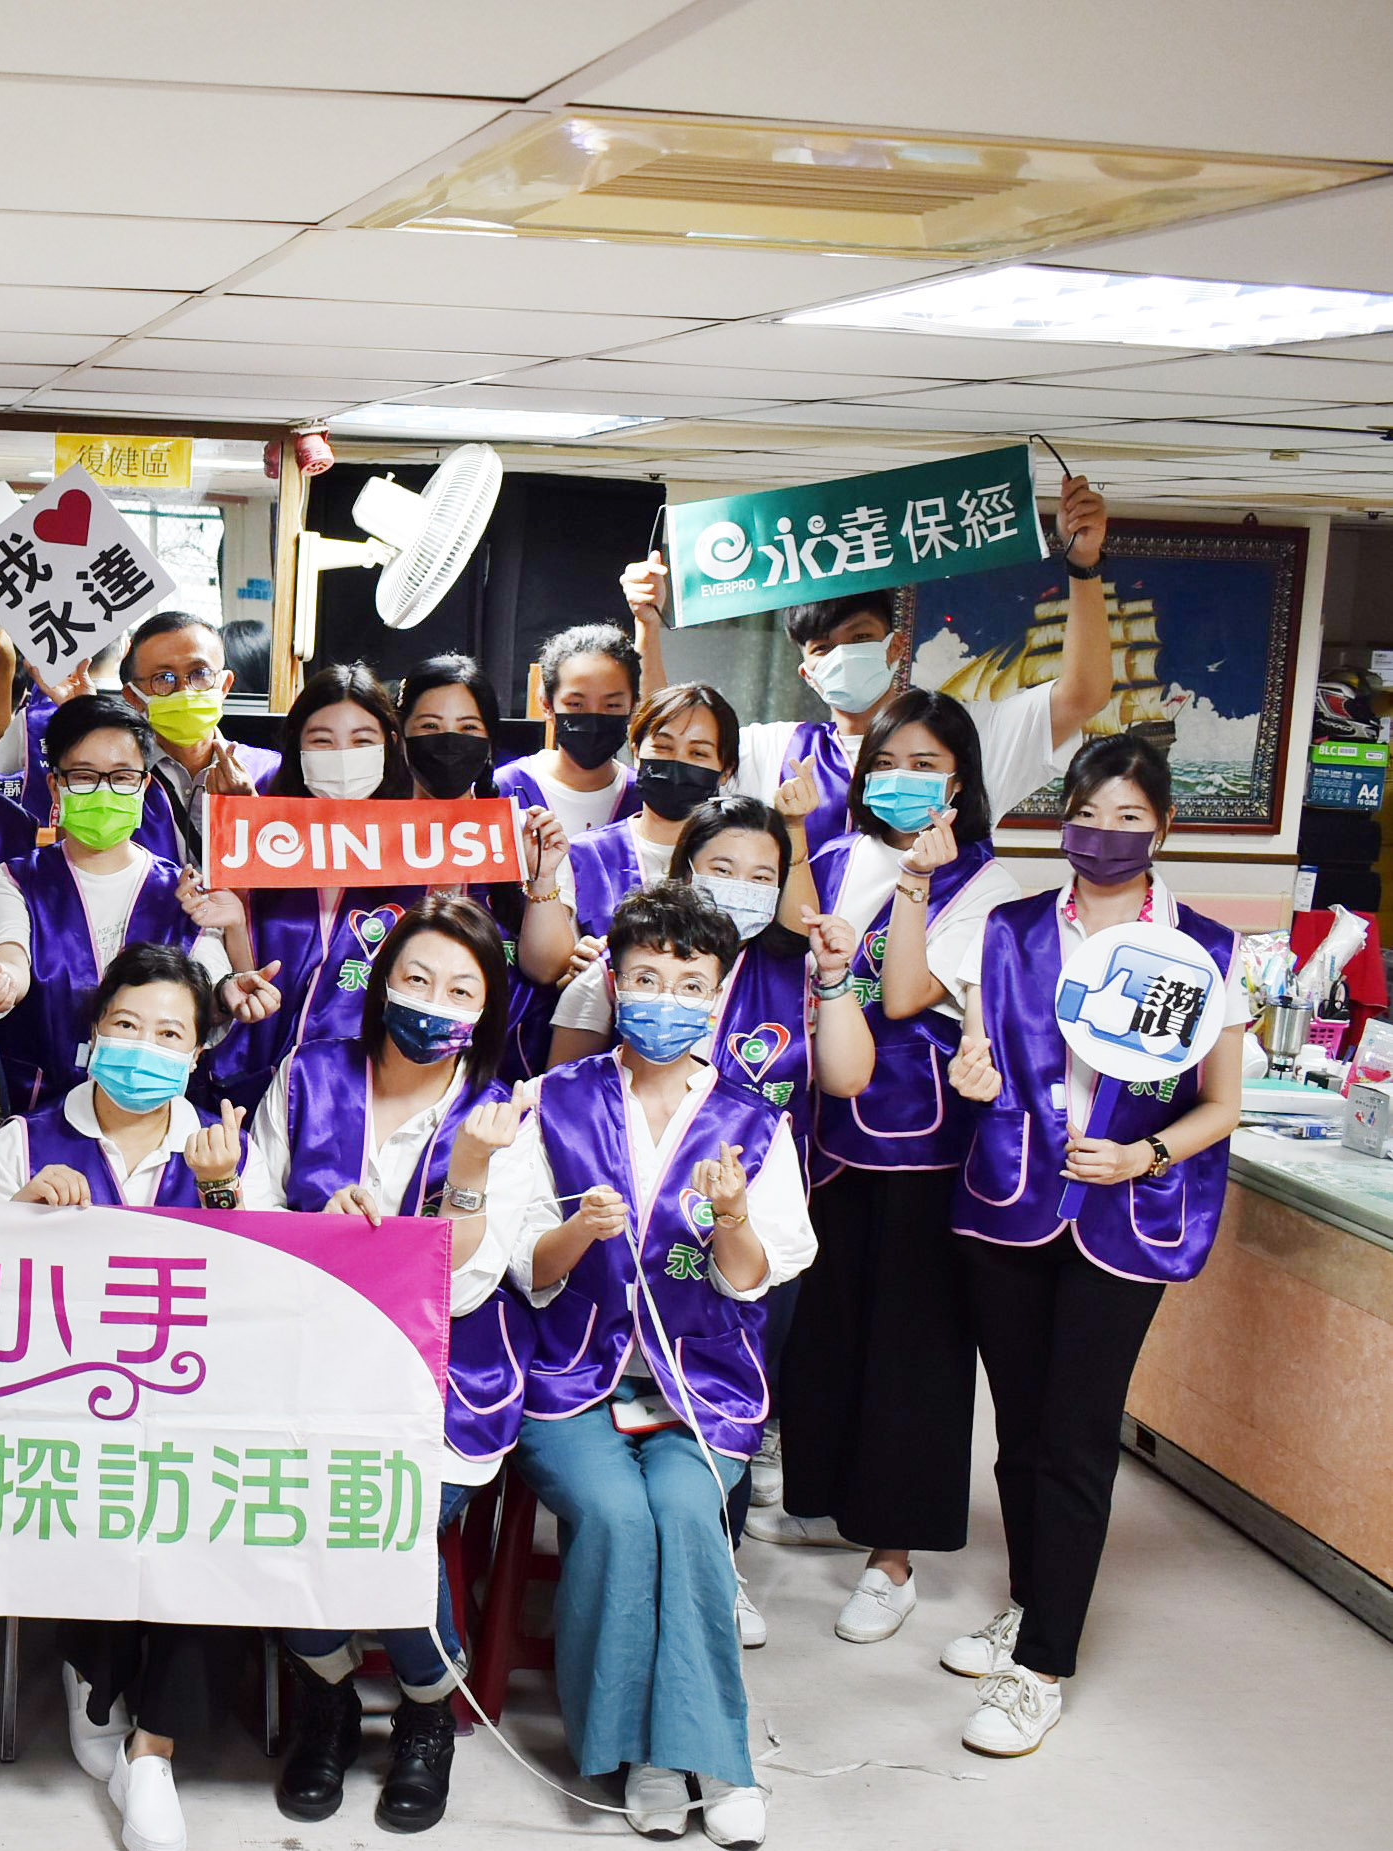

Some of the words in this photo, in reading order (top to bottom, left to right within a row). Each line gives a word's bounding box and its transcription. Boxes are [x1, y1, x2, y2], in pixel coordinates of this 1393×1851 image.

[75, 444, 172, 478] 復健區
[758, 482, 1018, 588] 永達保經
[29, 542, 155, 666] 永達
[701, 579, 756, 598] EVERPRO
[1318, 745, 1337, 756] BLC
[1357, 783, 1379, 800] A4
[220, 819, 382, 870] JOIN
[401, 821, 505, 869] US!
[337, 959, 372, 991] 永
[1130, 974, 1206, 1048] 讚
